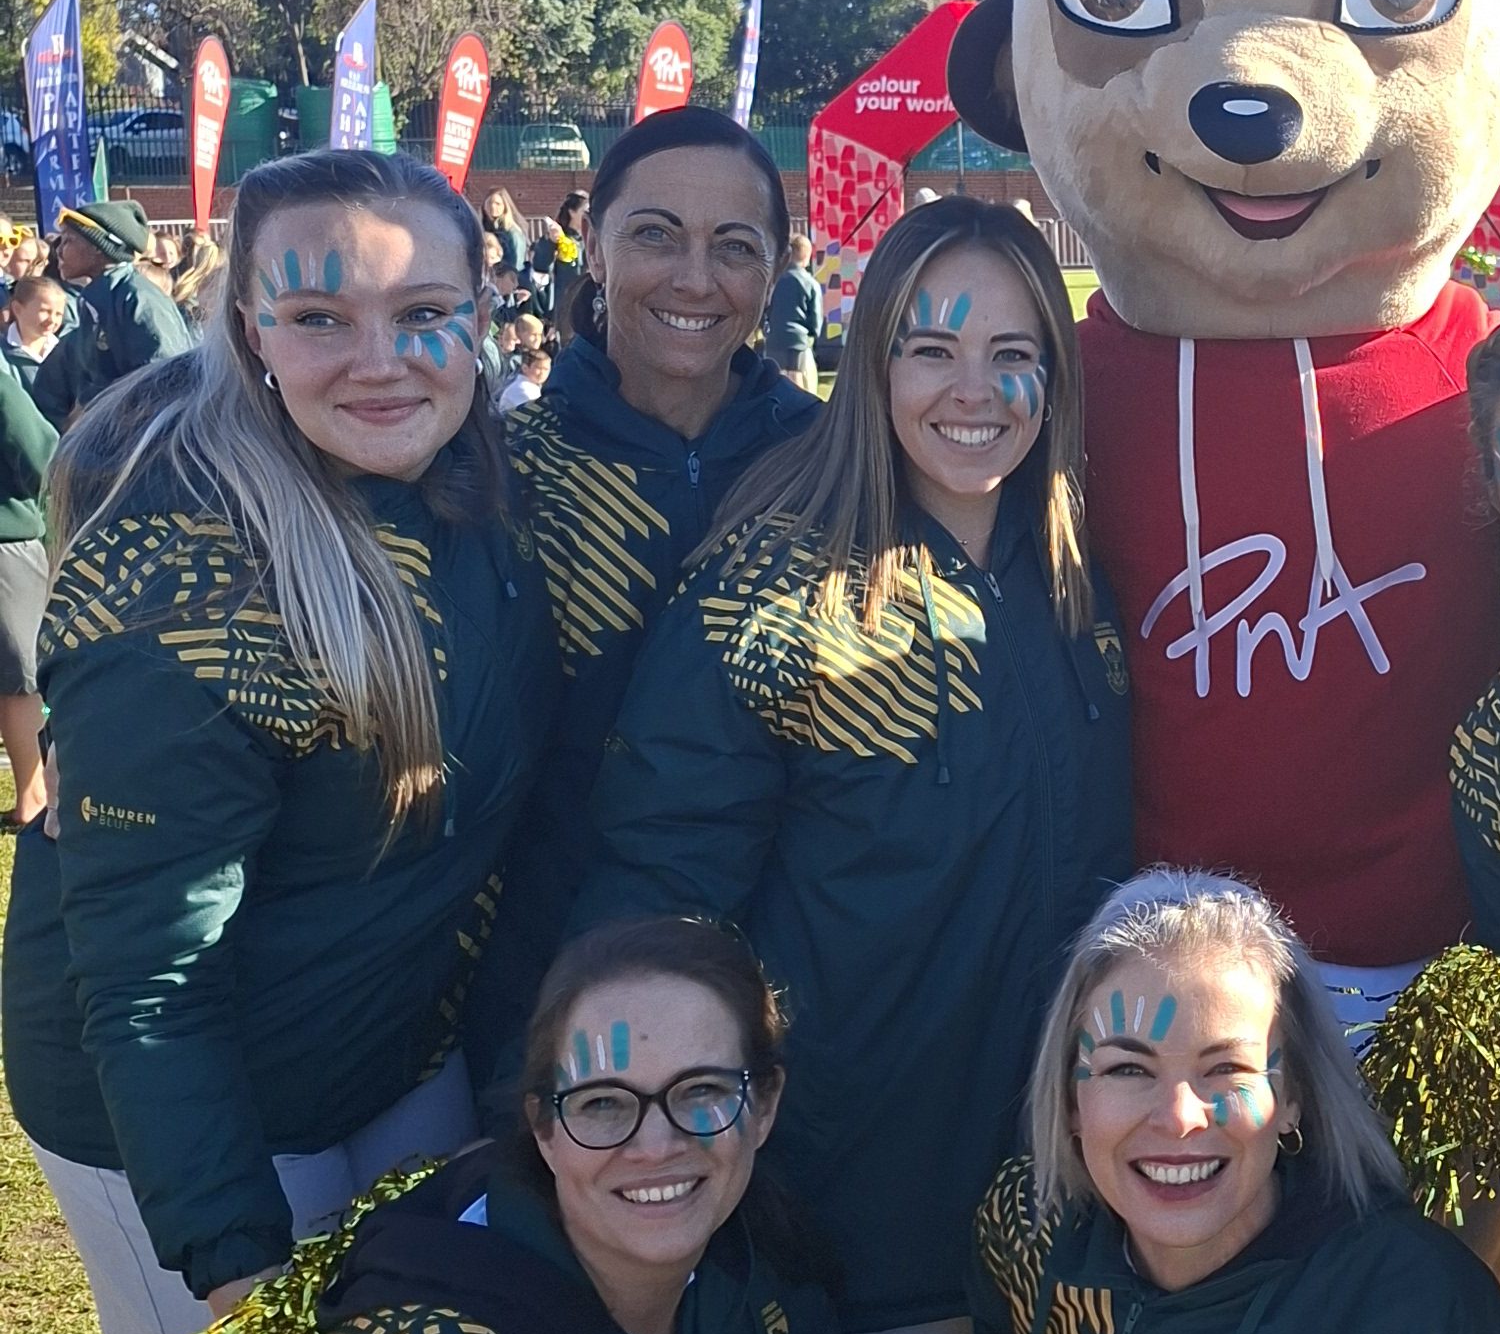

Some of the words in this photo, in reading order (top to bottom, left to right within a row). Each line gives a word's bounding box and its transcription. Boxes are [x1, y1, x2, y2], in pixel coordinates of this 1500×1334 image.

[857, 75, 921, 95] colour
[855, 96, 902, 114] your
[1140, 533, 1427, 698] PnA
[99, 814, 131, 831] BLUE
[100, 803, 156, 825] LAUREN
